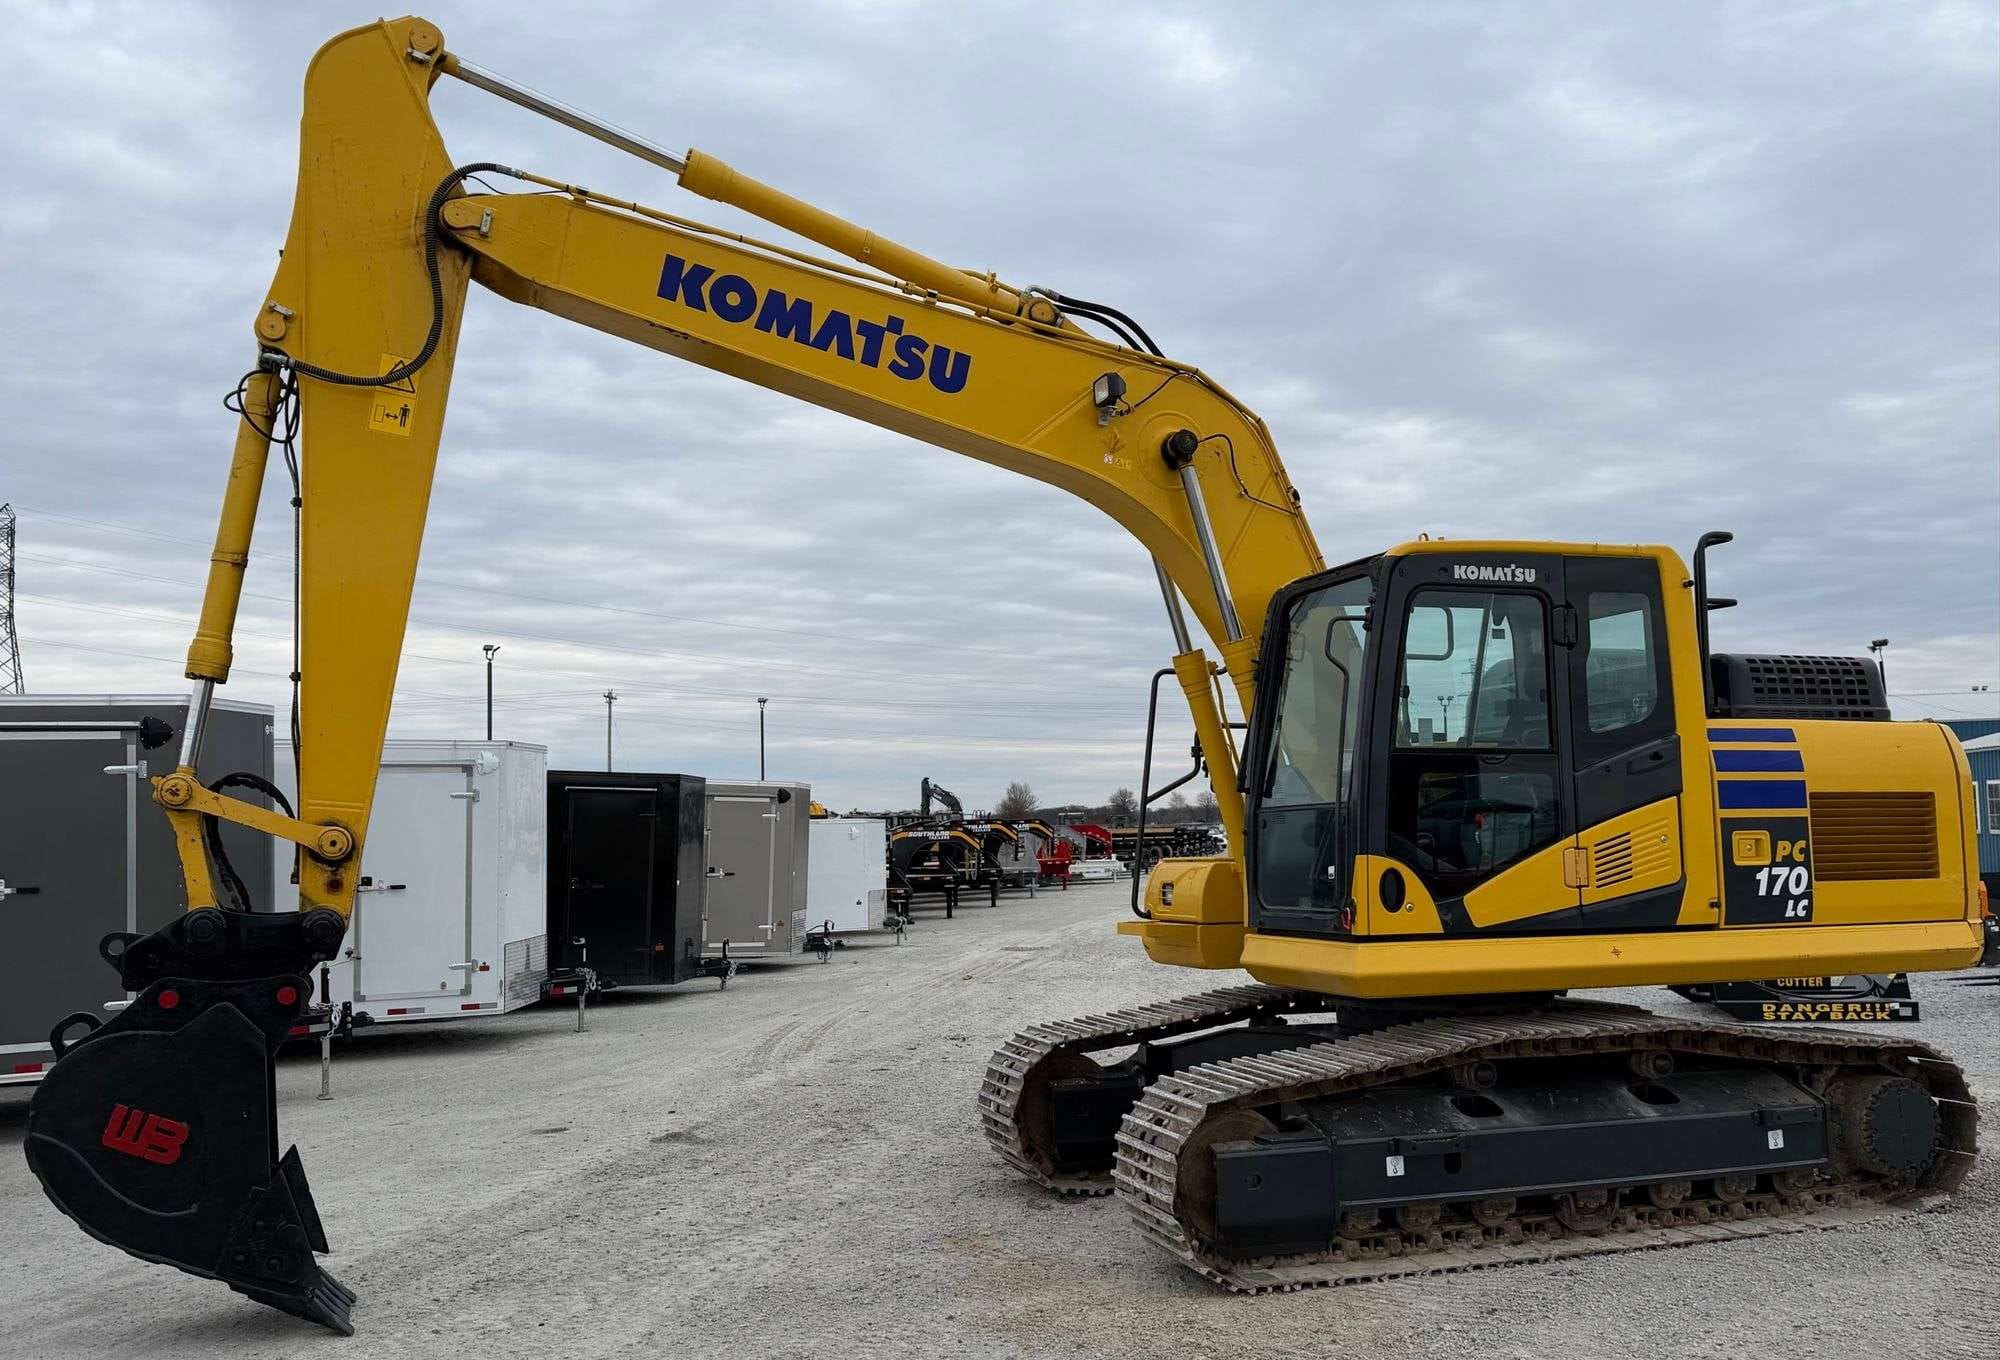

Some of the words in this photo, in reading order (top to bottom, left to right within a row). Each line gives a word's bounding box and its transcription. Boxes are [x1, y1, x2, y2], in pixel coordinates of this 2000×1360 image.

[656, 253, 972, 394] KOMATSU
[1453, 564, 1536, 583] KOMATSU
[1775, 840, 1807, 862] PC
[1755, 866, 1809, 896] 170
[1784, 899, 1809, 918] LC
[1777, 976, 1823, 987] CUTTER
[1762, 1003, 1890, 1012] DANGER!!!
[1762, 1012, 1822, 1020] STAY
[1830, 1012, 1891, 1020] BACK
[102, 1103, 190, 1165] WB
